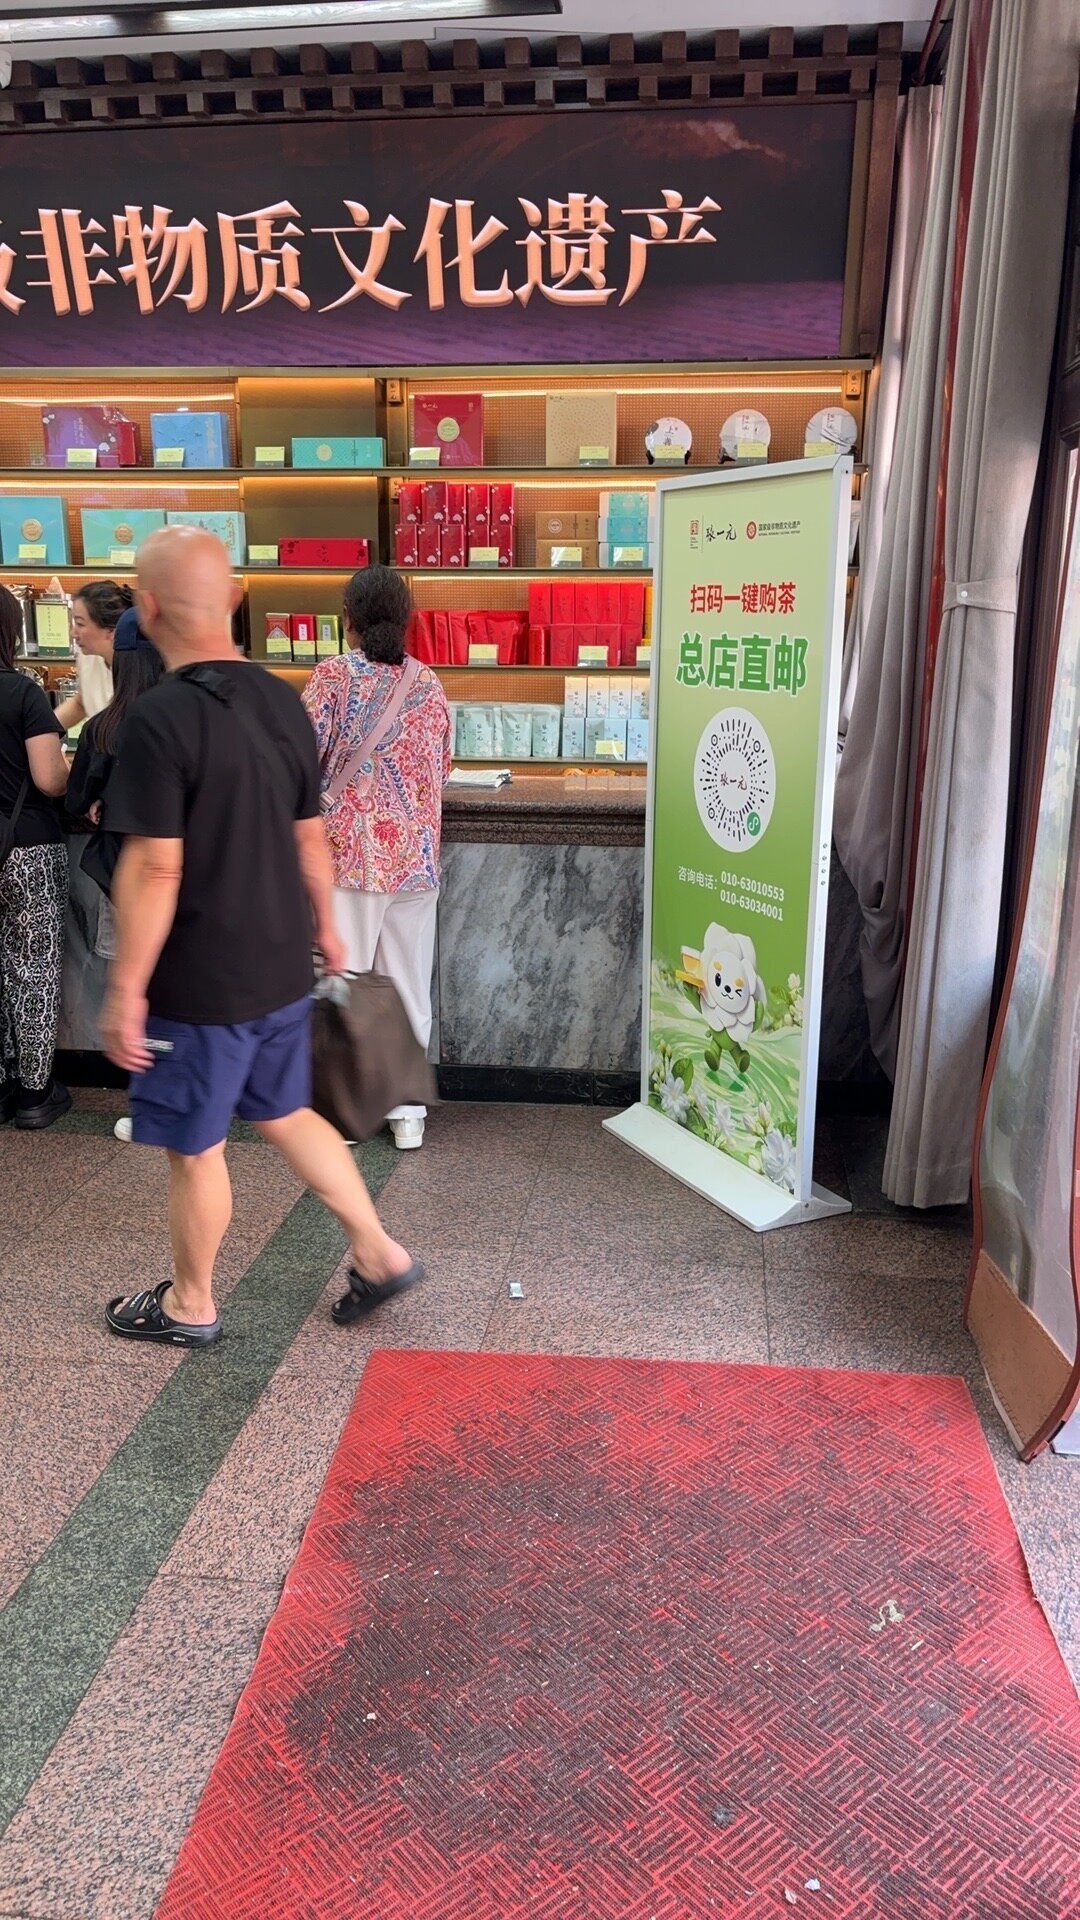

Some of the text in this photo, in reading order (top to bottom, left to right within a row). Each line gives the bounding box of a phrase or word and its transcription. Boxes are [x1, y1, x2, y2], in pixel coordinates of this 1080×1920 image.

[0, 188, 722, 317] 非物质文化遗产
[690, 582, 797, 614] 扫码一键购茶
[676, 631, 809, 697] 总店直邮
[721, 871, 785, 902] 010-63010553
[720, 890, 784, 921] 010-63034001
